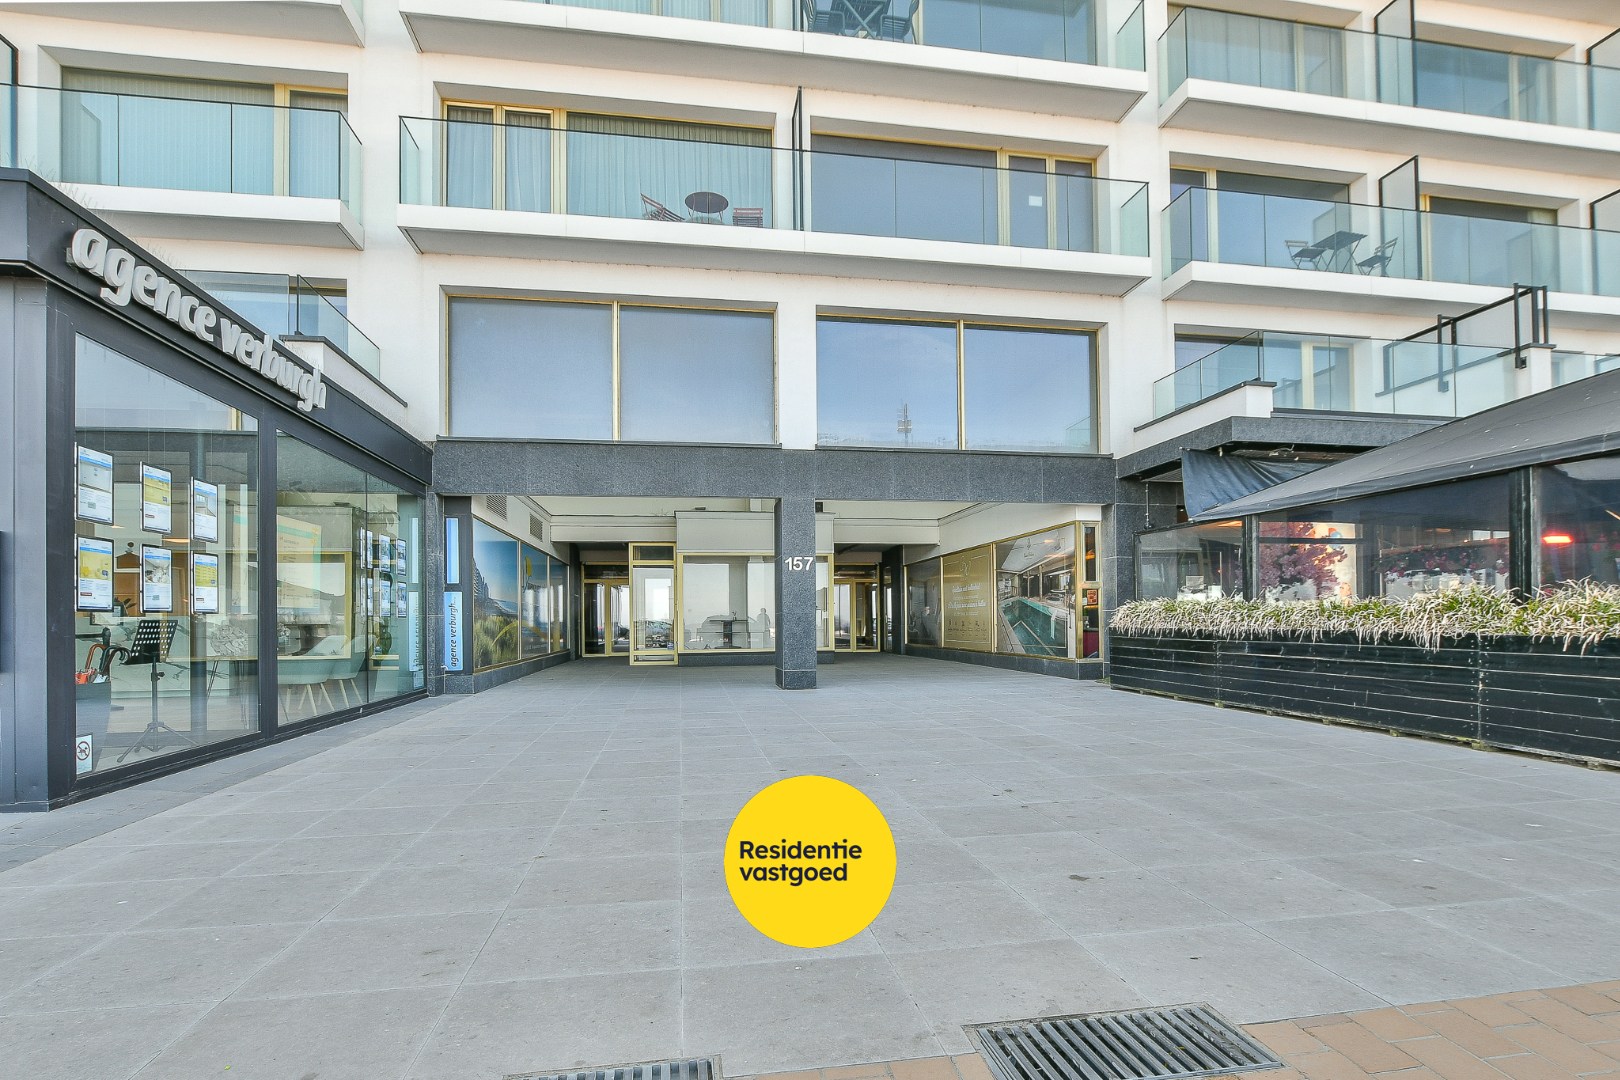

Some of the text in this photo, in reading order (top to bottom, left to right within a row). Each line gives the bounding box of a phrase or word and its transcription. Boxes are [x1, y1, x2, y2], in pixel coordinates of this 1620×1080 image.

[72, 228, 327, 412] agence verburgh
[784, 556, 814, 571] 157
[450, 639, 459, 668] agence
